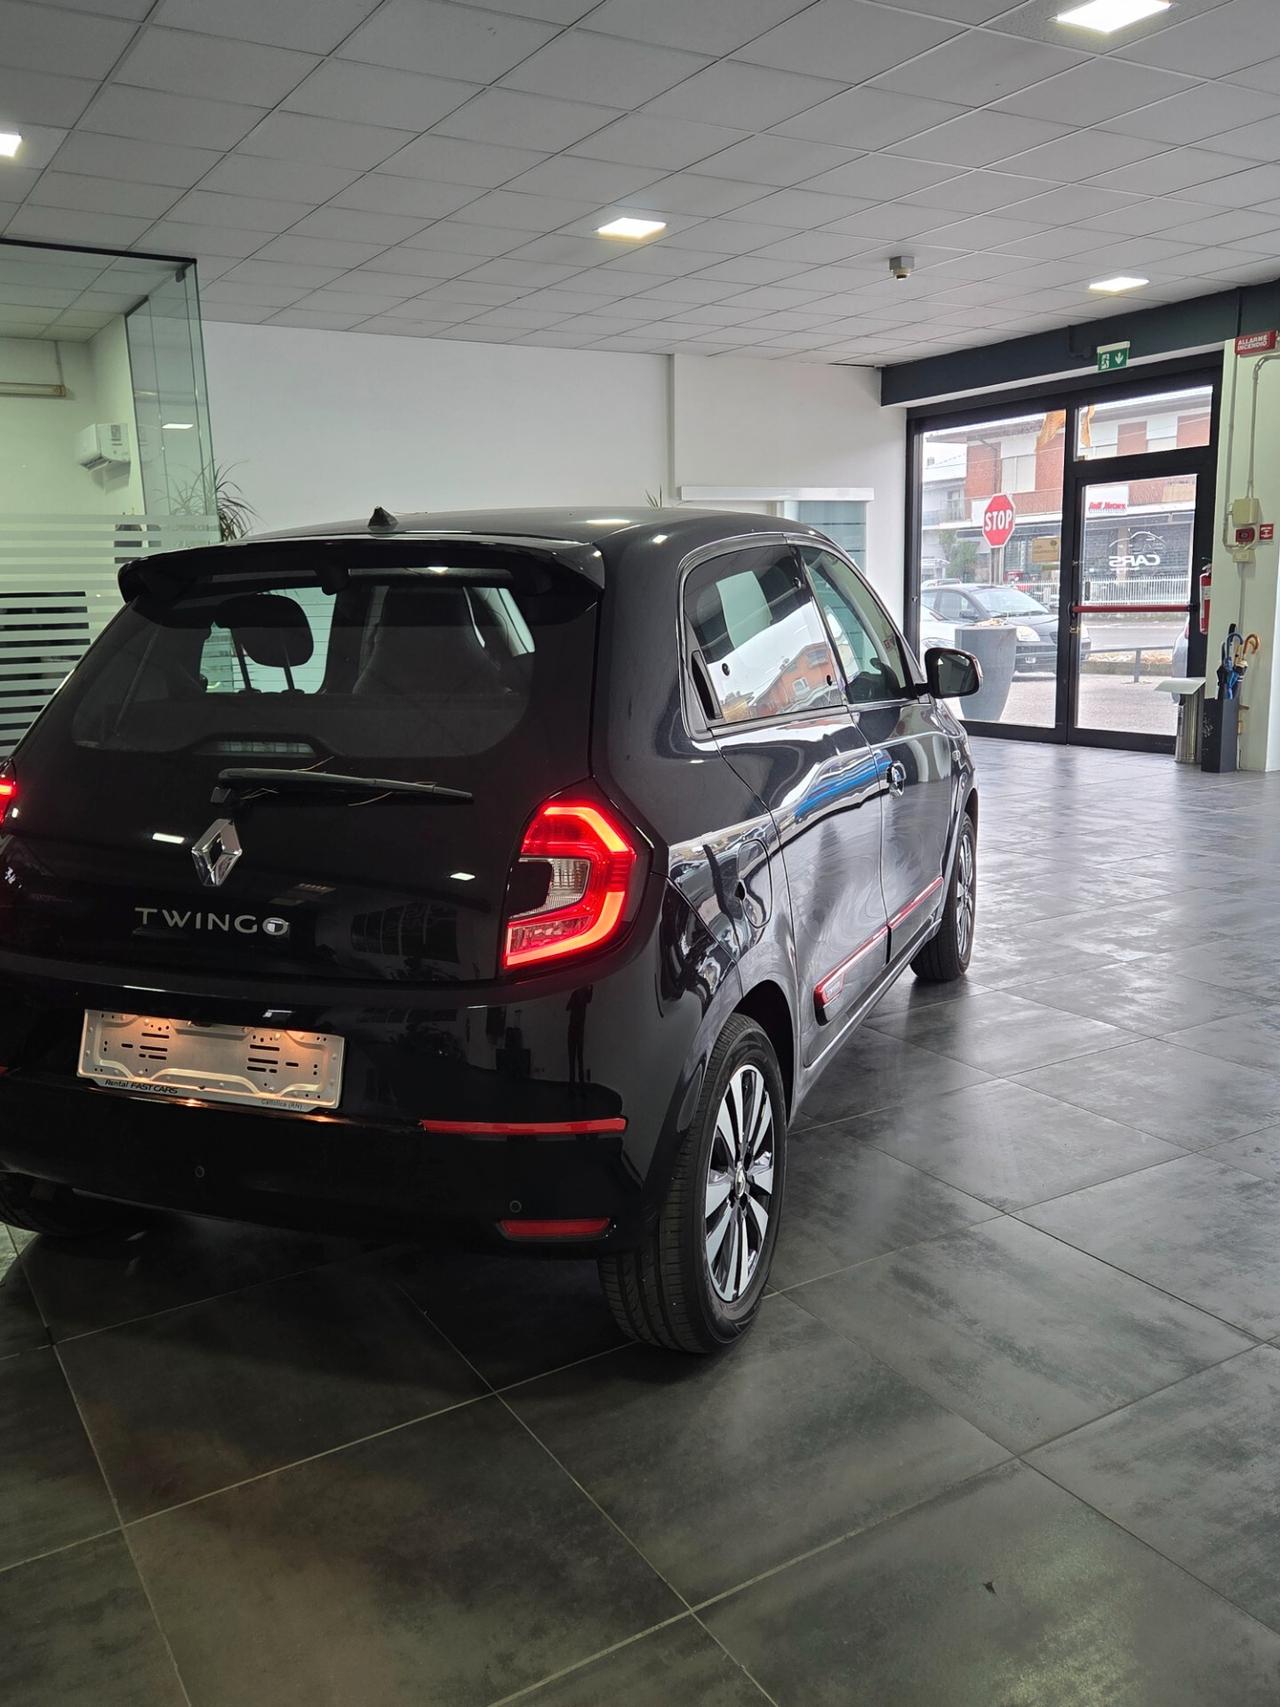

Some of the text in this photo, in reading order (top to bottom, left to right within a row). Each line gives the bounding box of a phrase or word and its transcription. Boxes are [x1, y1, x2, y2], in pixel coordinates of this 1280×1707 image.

[1238, 334, 1268, 345] ALLARME
[1238, 340, 1268, 350] INCENDIO
[985, 510, 1012, 531] STOP
[135, 907, 289, 936] TWINGO
[104, 1079, 178, 1095] Rental FAST CARS
